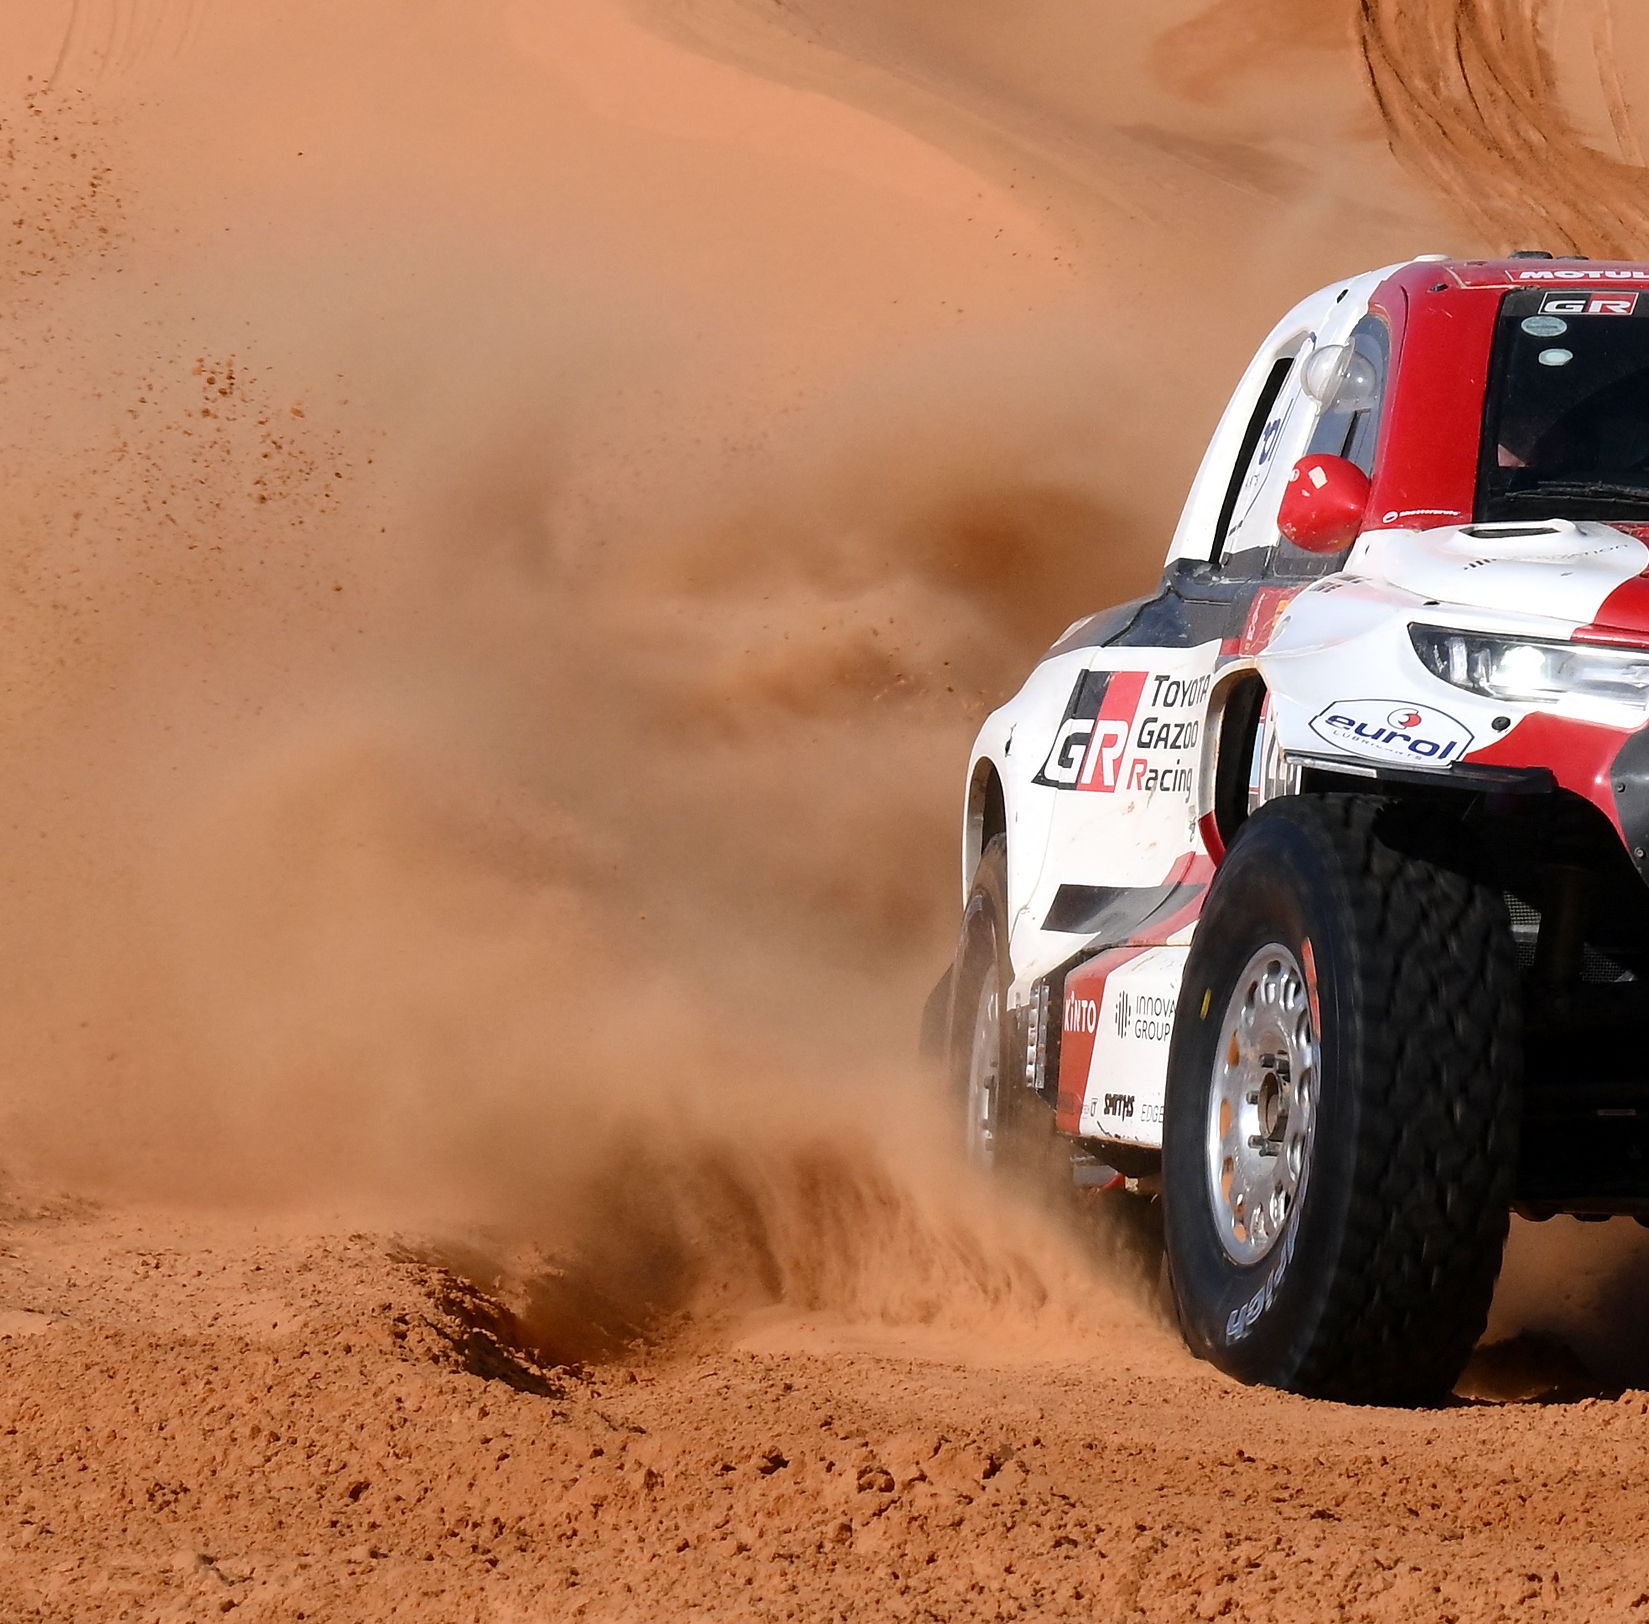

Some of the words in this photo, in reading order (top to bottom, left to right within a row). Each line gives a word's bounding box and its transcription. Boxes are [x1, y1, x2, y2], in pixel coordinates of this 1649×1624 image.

[1543, 299, 1632, 314] GR
[1150, 674, 1212, 708] TOYOTA
[1136, 717, 1199, 750] GAZOO
[1325, 714, 1458, 760] eurol
[1042, 717, 1131, 787] GR
[1126, 758, 1194, 804] Racing
[1134, 1019, 1171, 1042] GROUP
